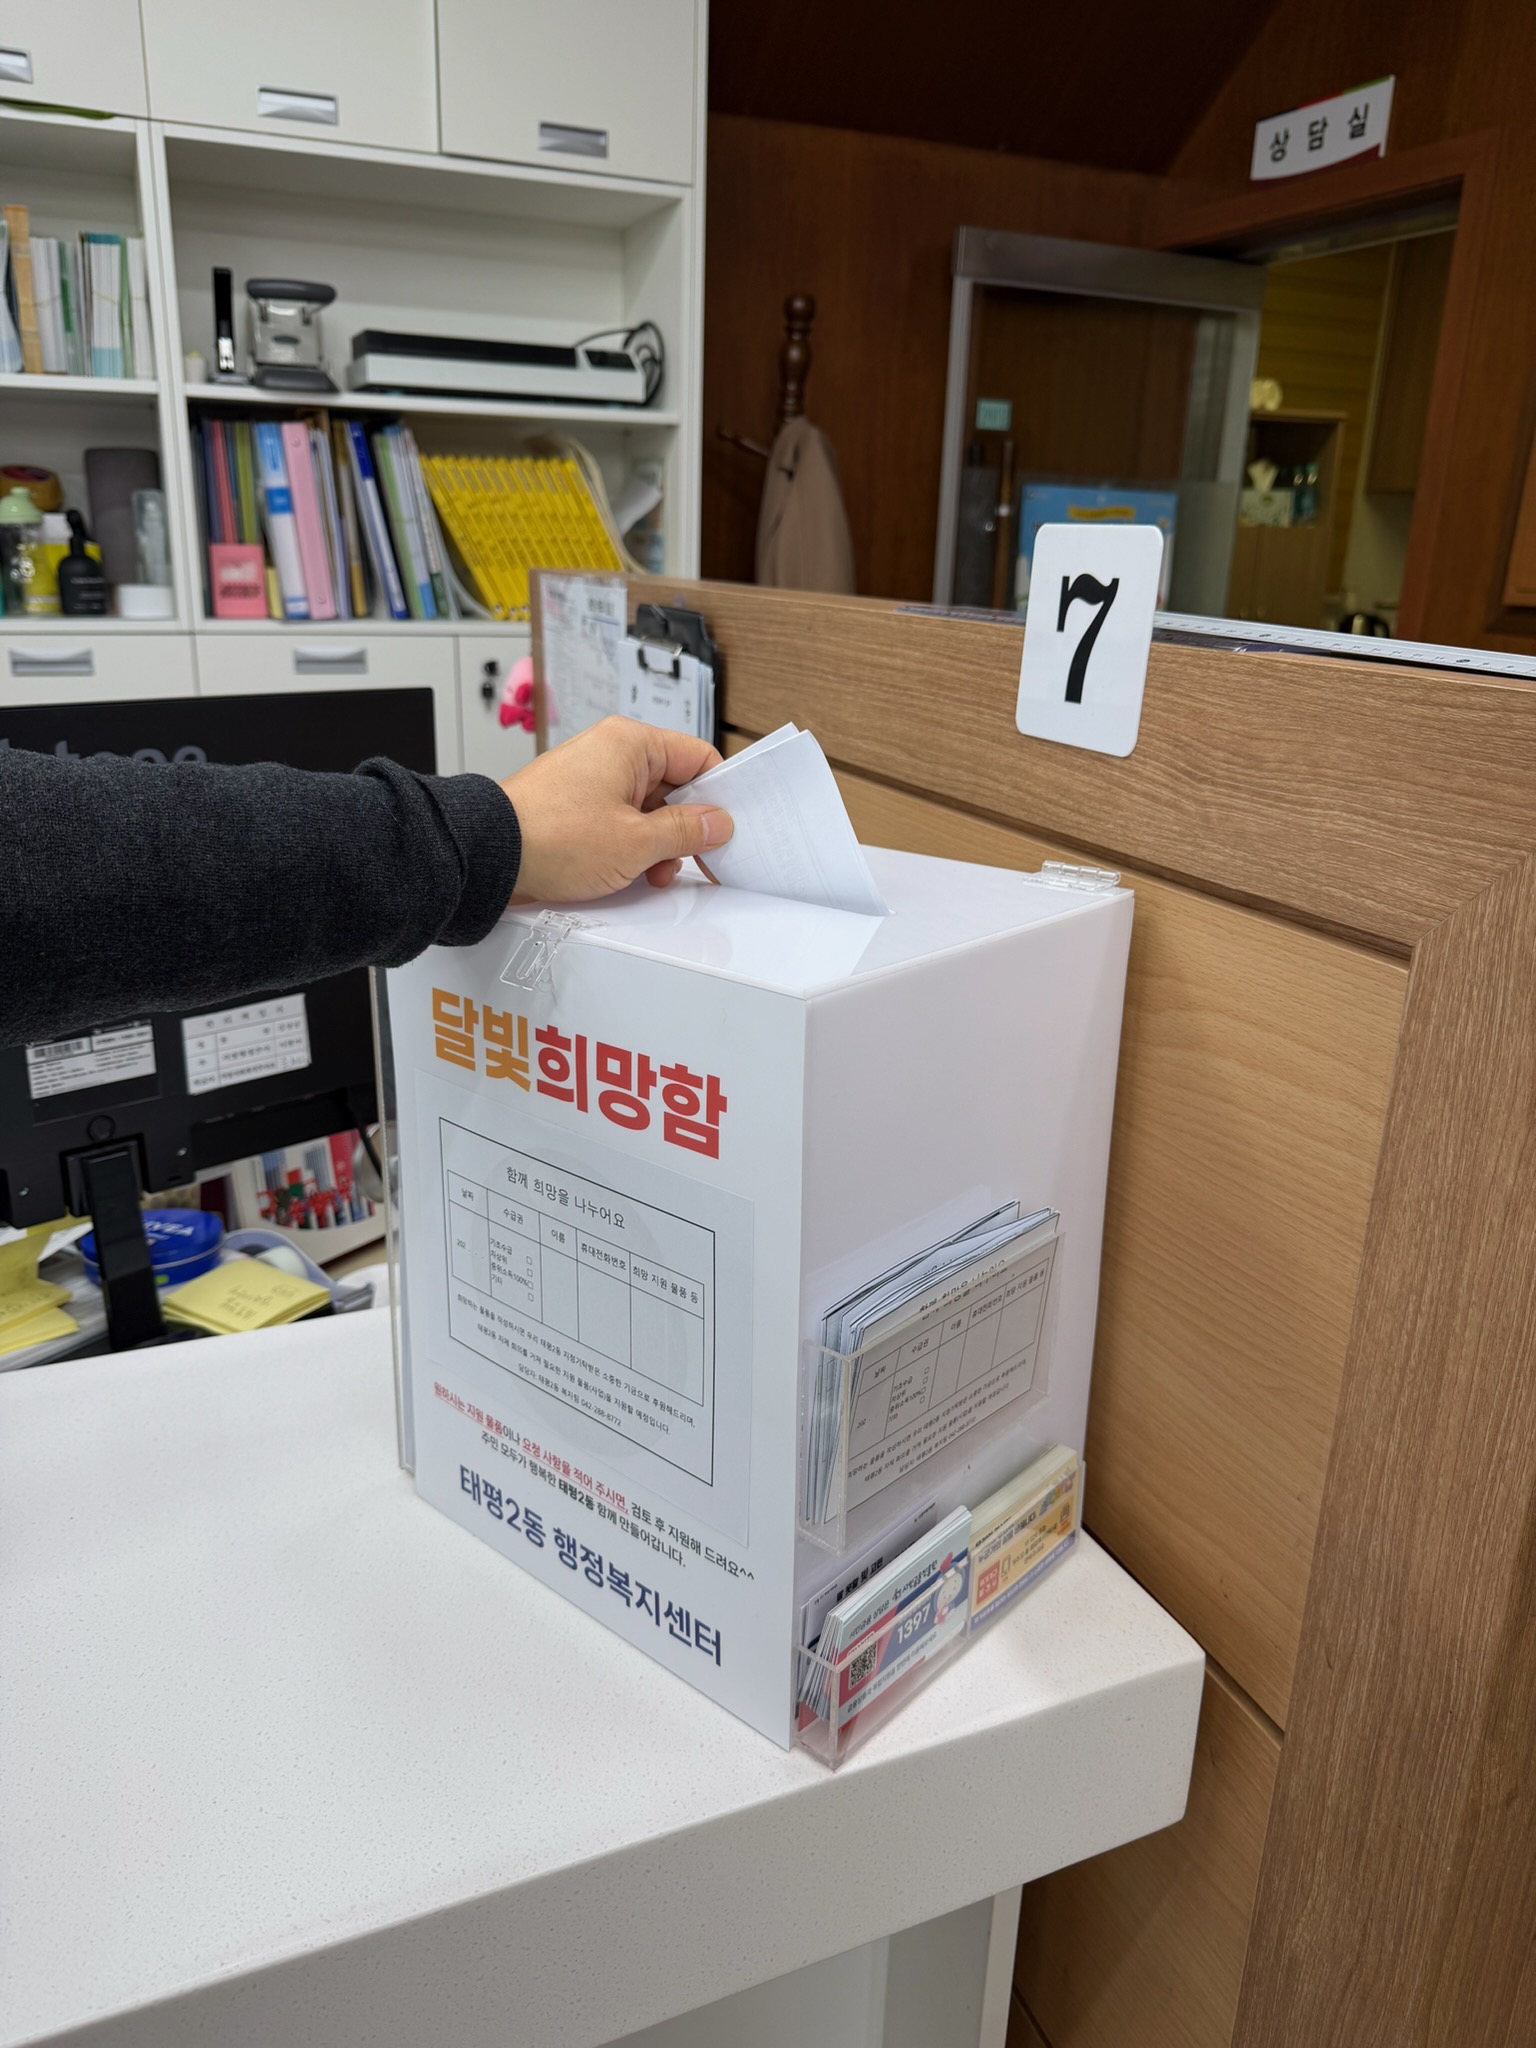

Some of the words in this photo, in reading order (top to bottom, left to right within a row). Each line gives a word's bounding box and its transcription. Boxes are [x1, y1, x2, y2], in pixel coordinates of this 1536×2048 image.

[1057, 572, 1119, 704] 7
[503, 1208, 523, 1224] 수급권
[506, 1166, 528, 1189] 함께
[533, 1178, 569, 1207] 희망을
[574, 1196, 625, 1229] 나누어요
[551, 1229, 565, 1243] 이름
[581, 1243, 626, 1270] 휴대전화번호
[633, 1266, 648, 1281] 희망
[651, 1274, 667, 1290] 지원
[671, 1282, 687, 1299] 물품
[690, 1291, 698, 1304] 등
[481, 1430, 498, 1451] 주민
[501, 1443, 527, 1468] 모두가
[529, 1460, 556, 1487] 행복한
[558, 1478, 594, 1510] 태평2동
[597, 1502, 617, 1525] 함께
[619, 1515, 685, 1567] 만들어갑니다.
[461, 1464, 545, 1548] 태평2동
[553, 1526, 721, 1667] 행정복지센터
[897, 1603, 930, 1644] 1397
